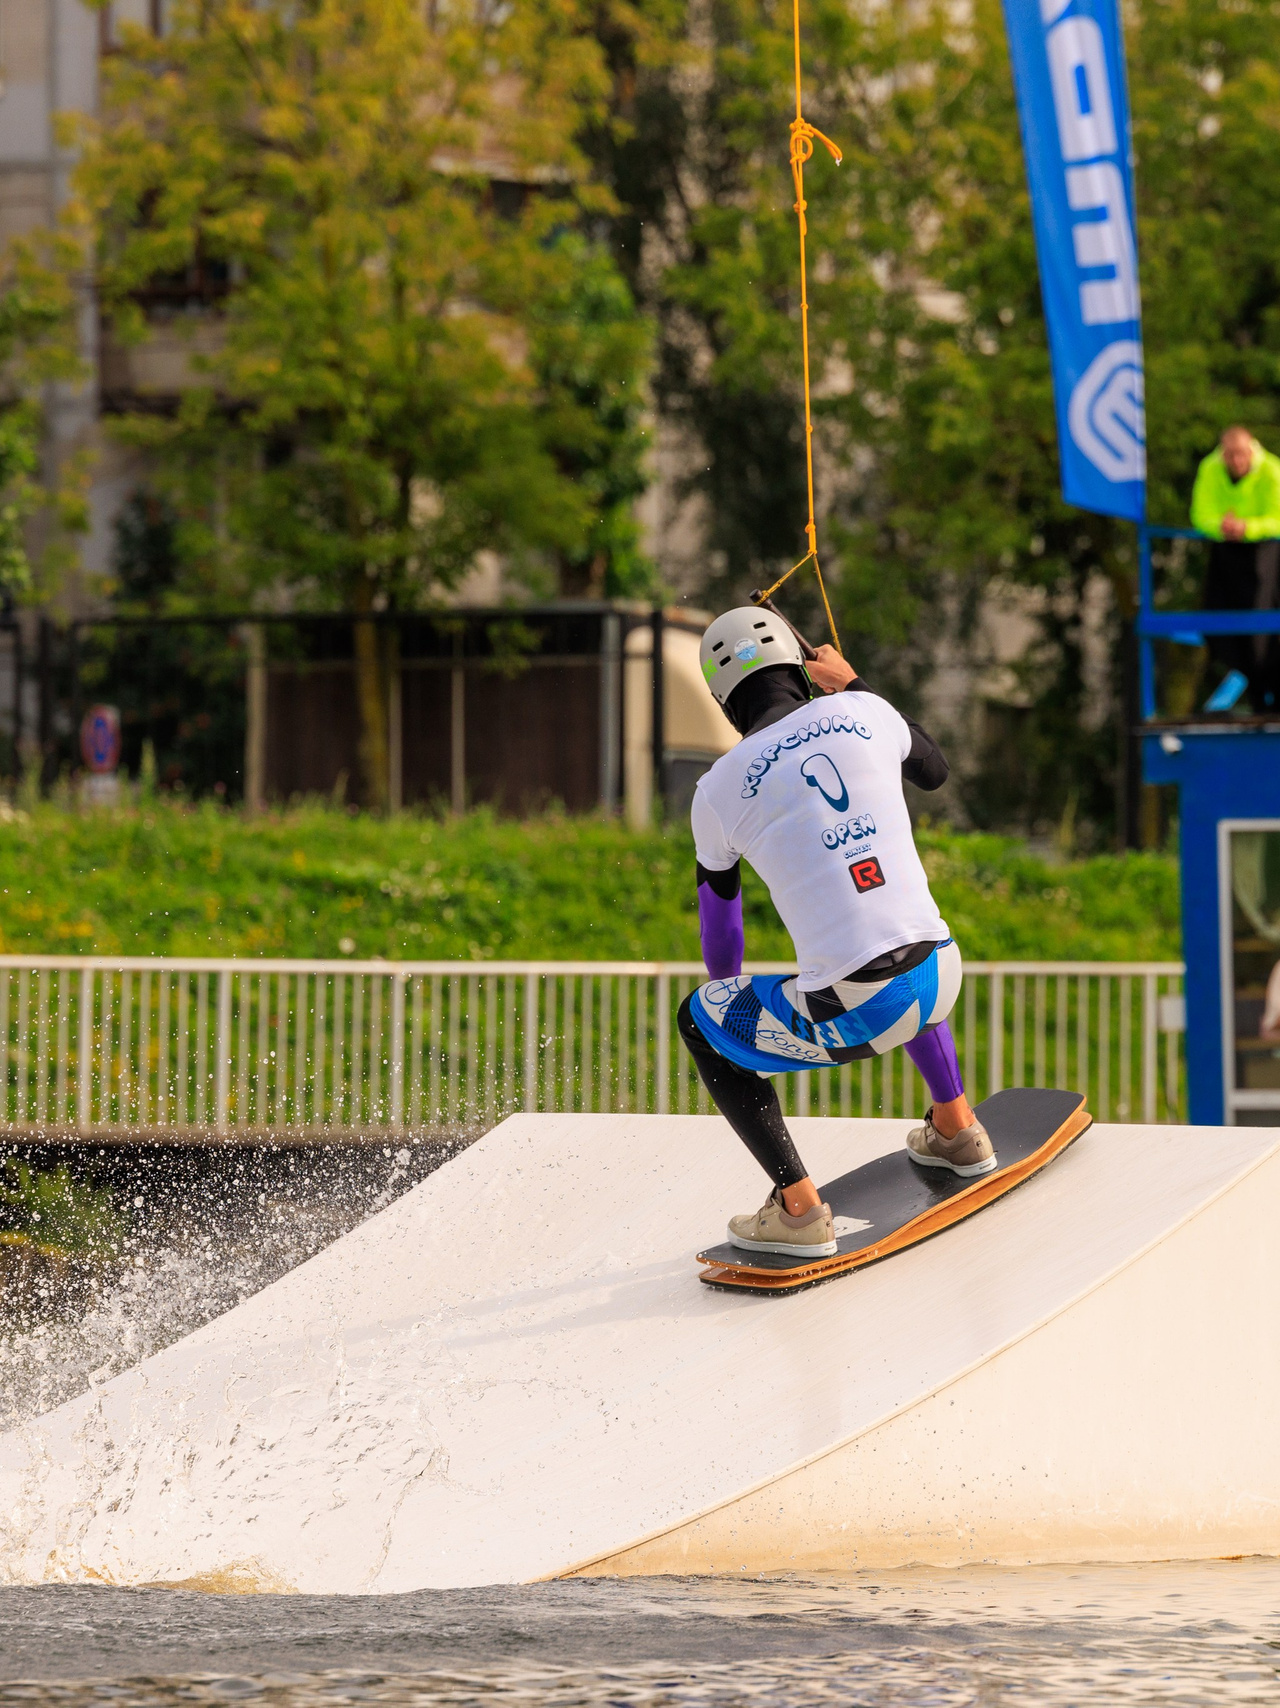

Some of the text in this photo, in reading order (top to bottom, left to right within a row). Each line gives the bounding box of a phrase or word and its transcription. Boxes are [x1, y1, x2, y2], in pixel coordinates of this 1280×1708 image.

[741, 714, 873, 799] KUPCHINO
[800, 752, 850, 813] 1
[821, 813, 877, 850] OPEN
[843, 843, 872, 859] CONTEST
